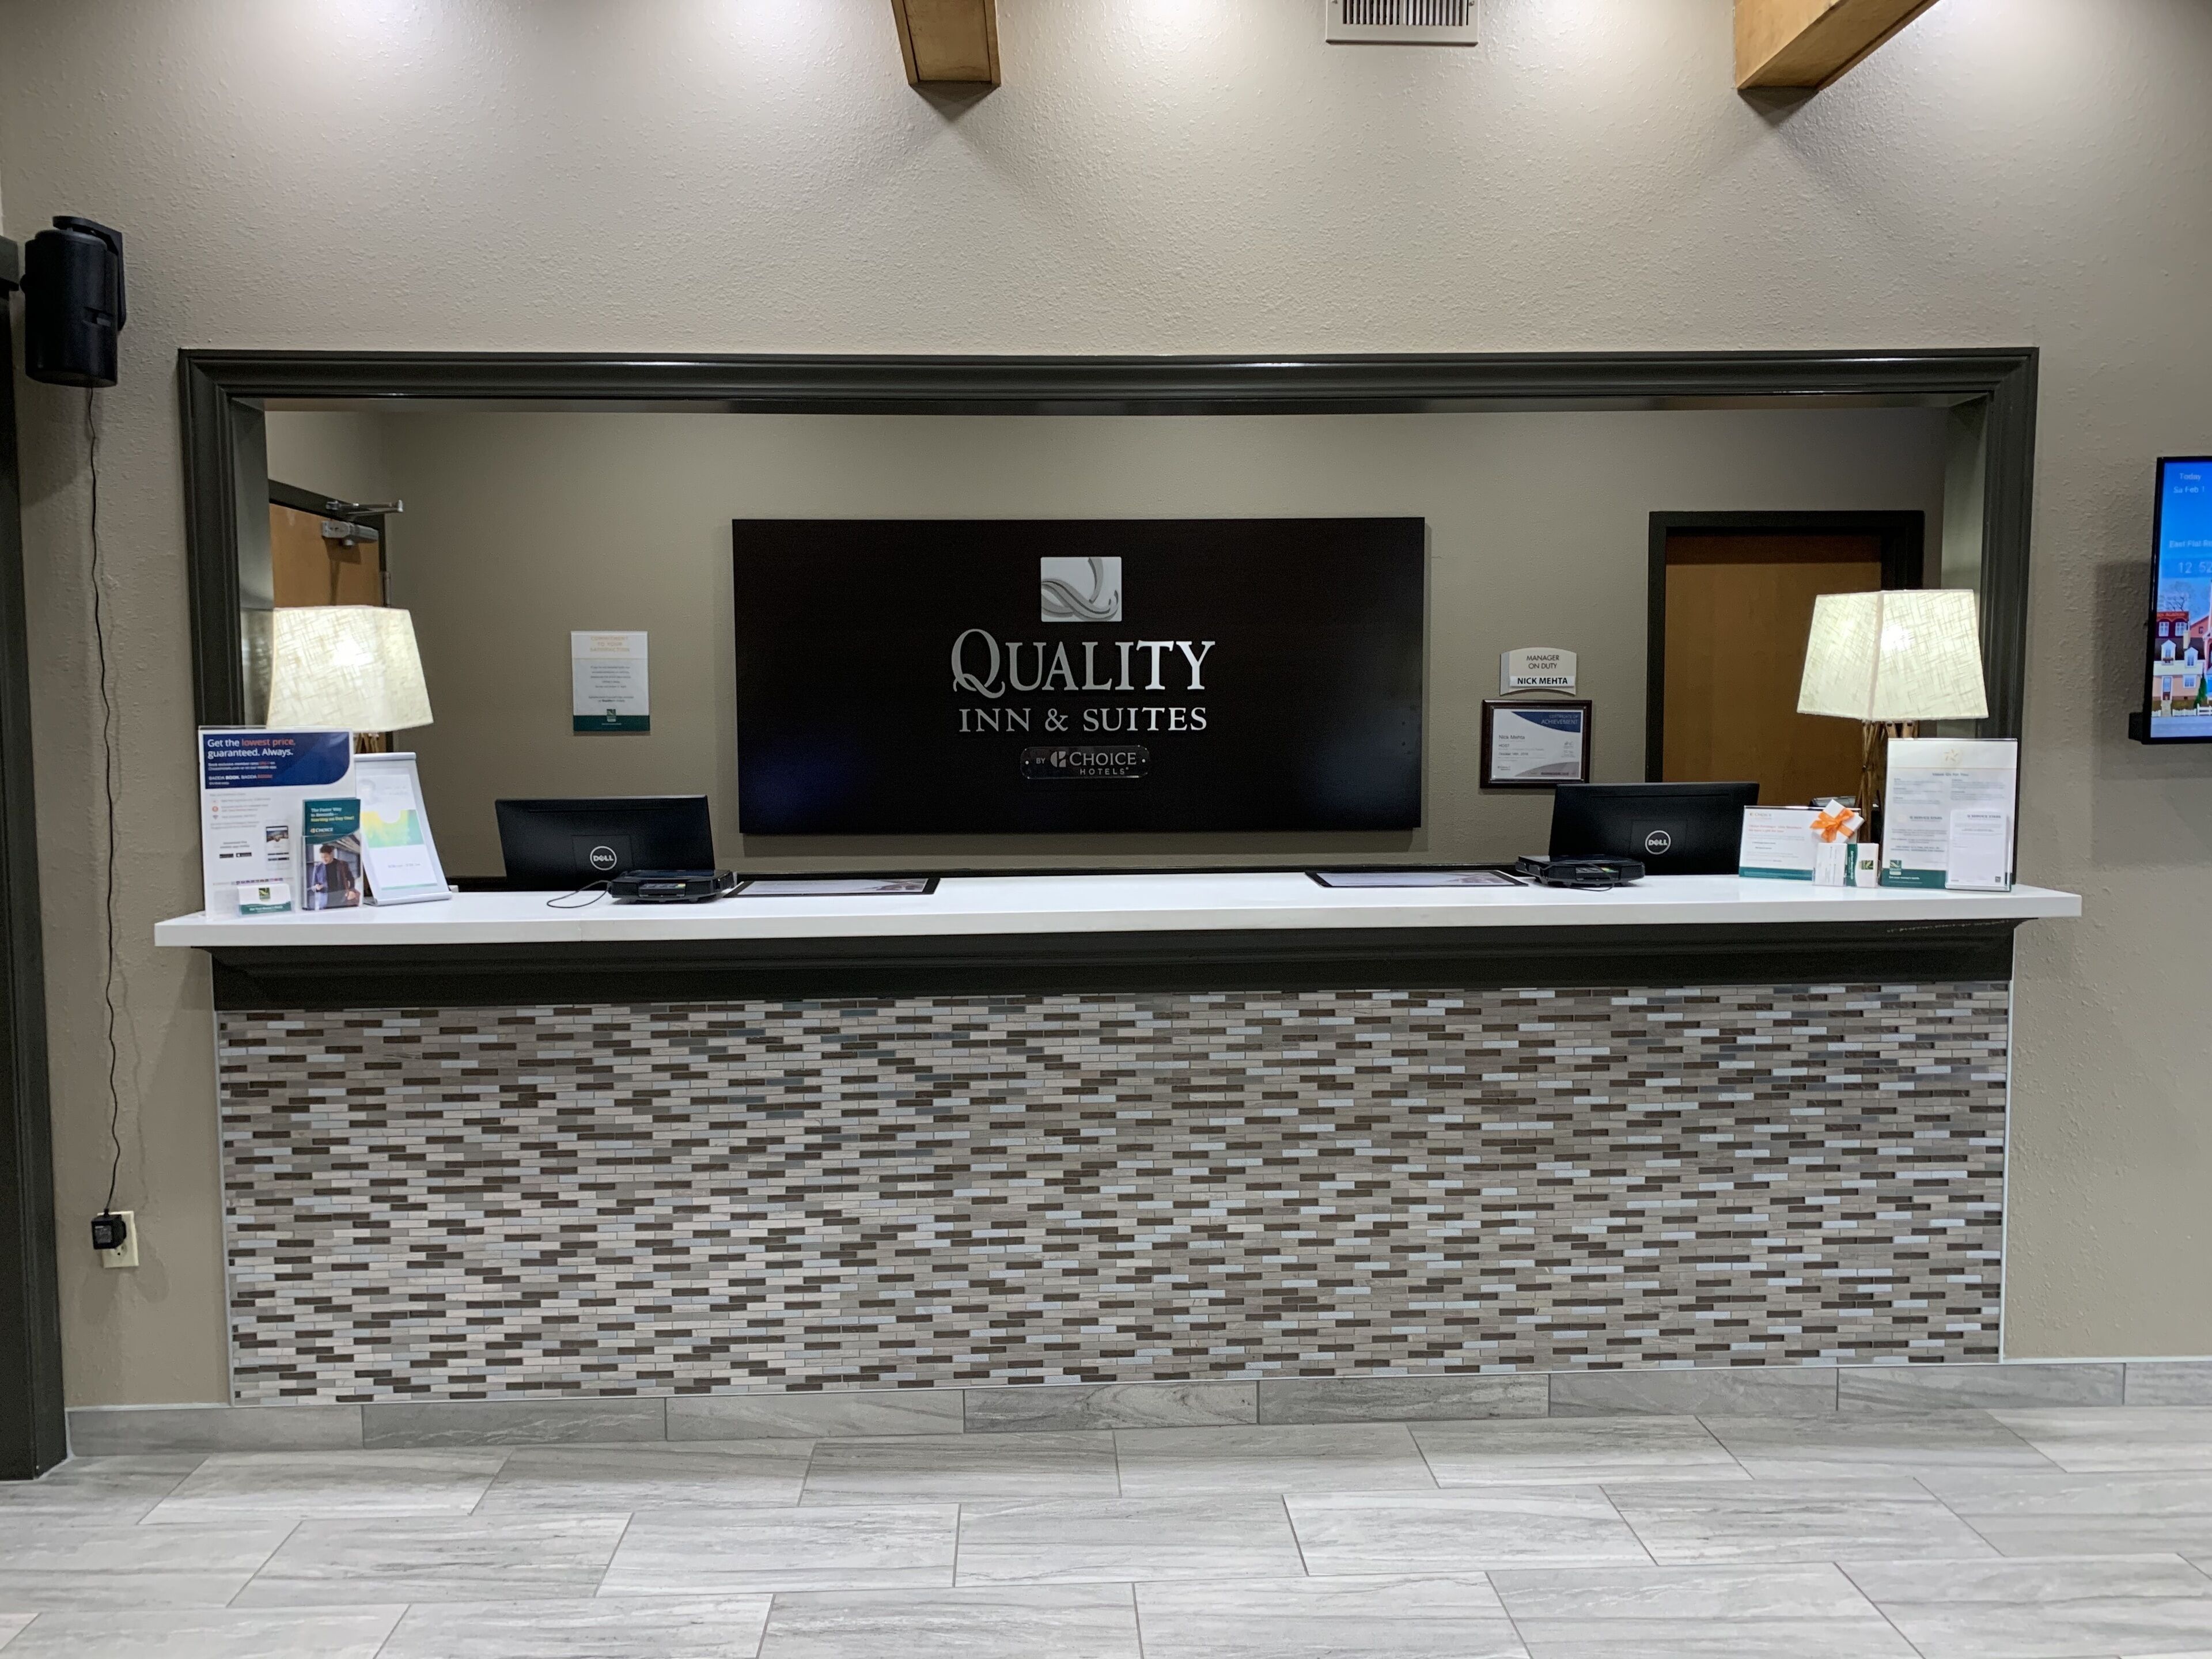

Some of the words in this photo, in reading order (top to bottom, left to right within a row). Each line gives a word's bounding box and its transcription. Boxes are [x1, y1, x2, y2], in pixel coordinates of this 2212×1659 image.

[2179, 473, 2202, 482] Today
[951, 628, 1215, 699] QUALITY
[959, 708, 1031, 732] INN
[1044, 708, 1069, 732] &
[1083, 707, 1207, 732] SUITES
[207, 739, 224, 747] Get
[225, 738, 240, 747] the
[241, 738, 270, 747] lowest
[208, 748, 260, 759] guaranteed.
[262, 748, 293, 757] Always.
[1069, 752, 1137, 766] CHOICE
